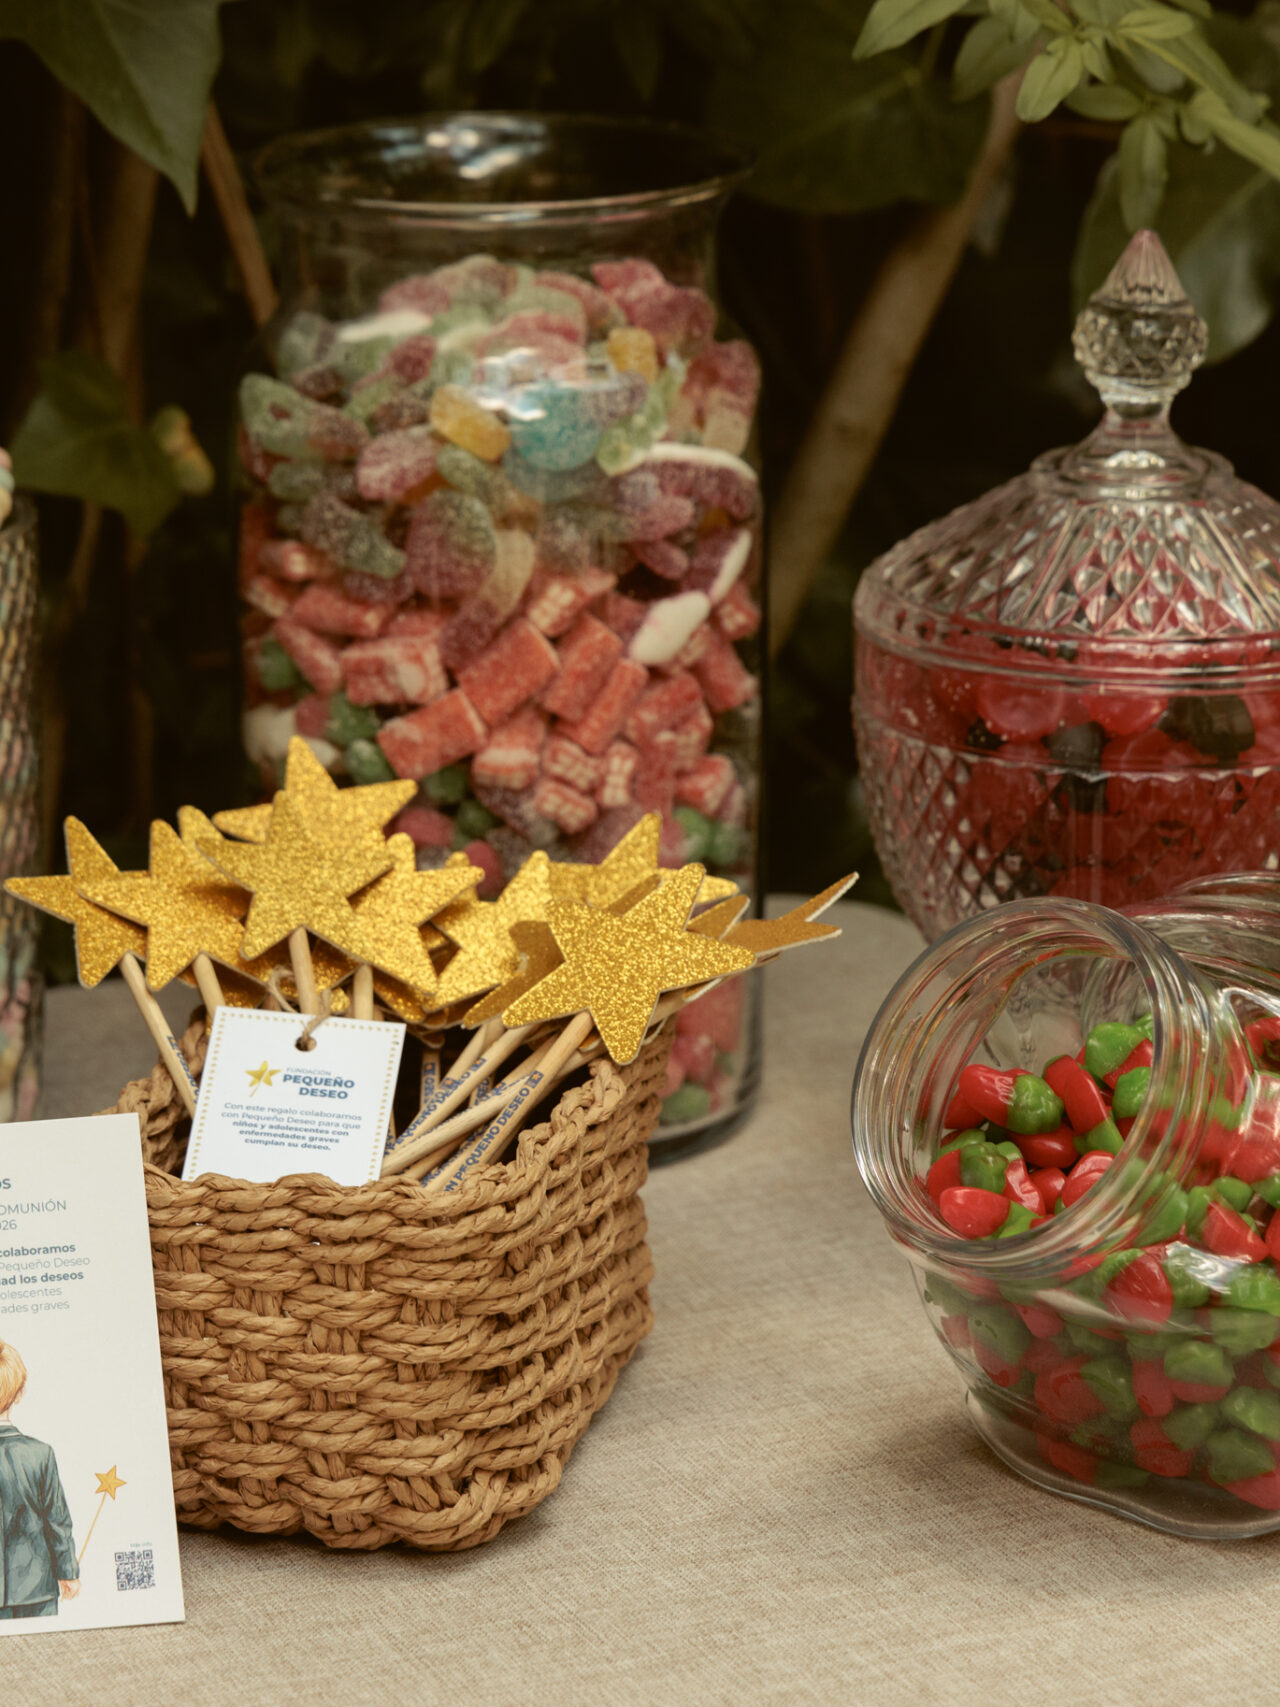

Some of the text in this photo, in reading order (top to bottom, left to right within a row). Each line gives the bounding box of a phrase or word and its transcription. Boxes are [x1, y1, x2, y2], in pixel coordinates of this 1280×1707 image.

[283, 1074, 355, 1088] PEQUEÑO
[299, 1087, 348, 1099] DESEO
[224, 1102, 362, 1121] Con este regalo colaboramos
[496, 1087, 530, 1127] DESEO
[232, 1120, 258, 1129] niños
[268, 1124, 330, 1135] adolescentes
[241, 1112, 285, 1124] Pequeño
[287, 1117, 316, 1126] Deseo
[318, 1120, 340, 1129] para
[342, 1122, 361, 1131] que
[239, 1129, 340, 1144] enfermedades graves
[244, 1137, 286, 1148] cumplan
[300, 1142, 332, 1151] deseo.
[53, 1256, 91, 1268] Deseo
[19, 1273, 38, 1284] los
[40, 1270, 84, 1283] deseos
[30, 1300, 70, 1314] graves
